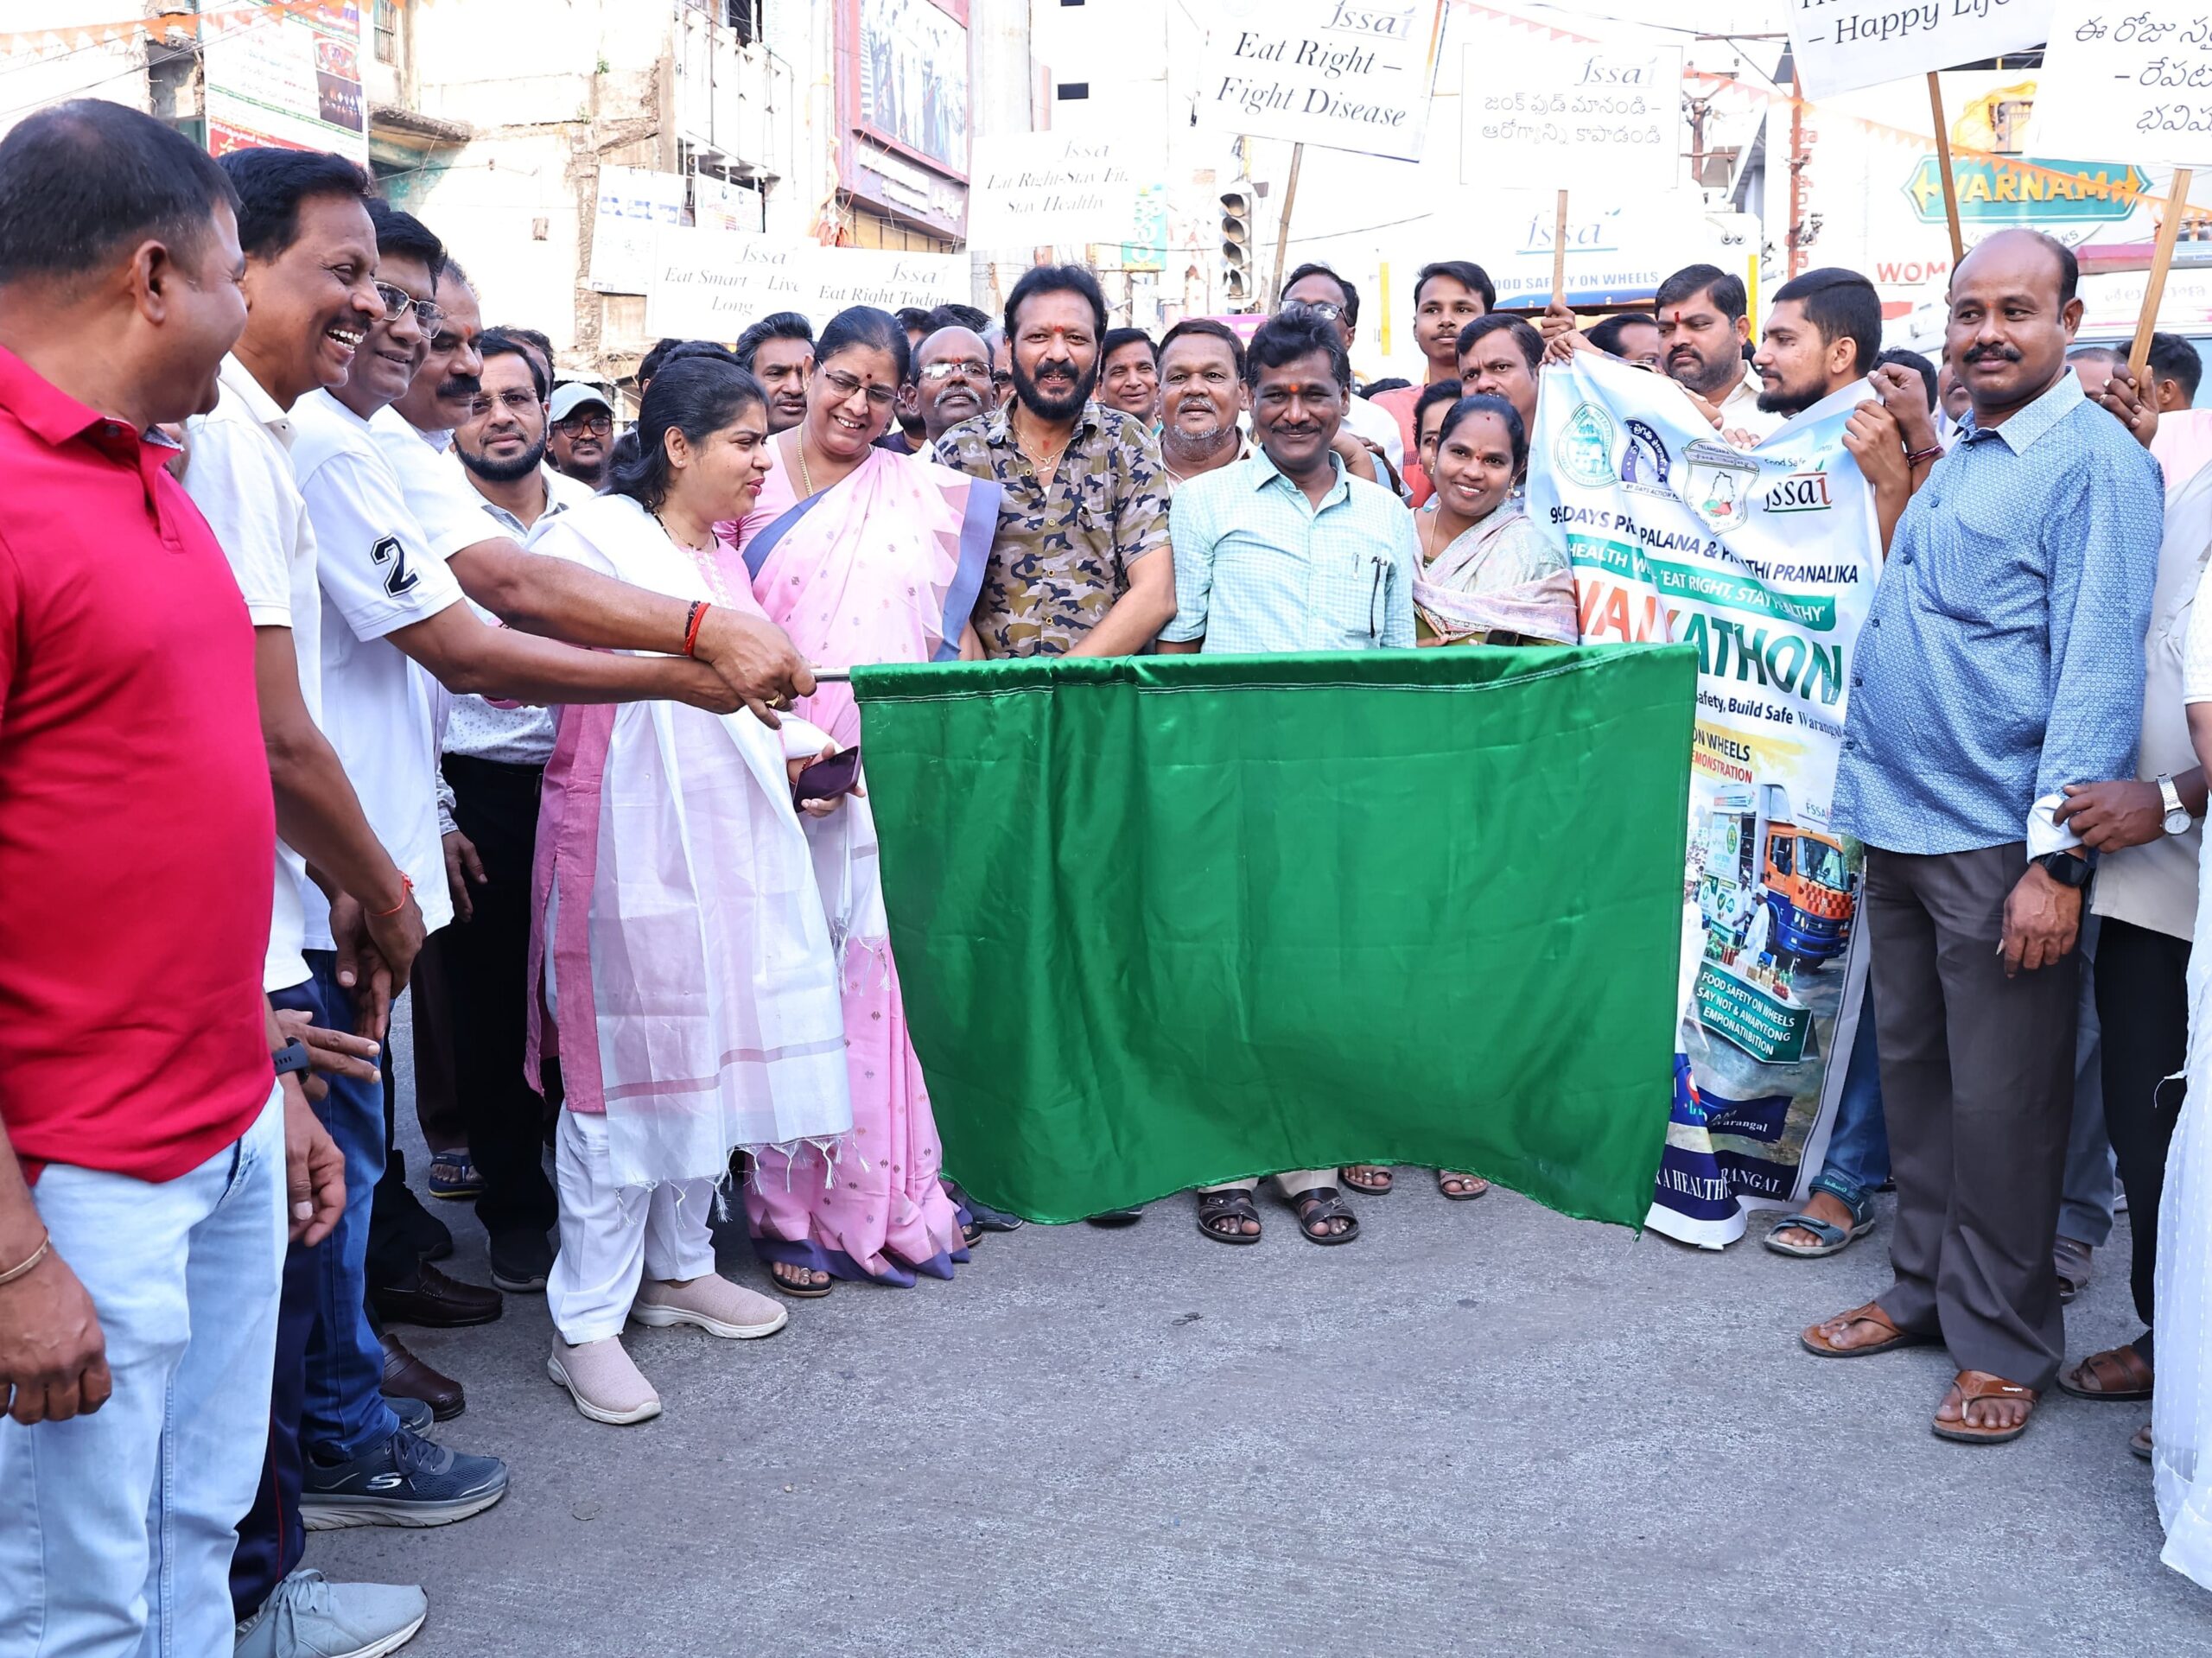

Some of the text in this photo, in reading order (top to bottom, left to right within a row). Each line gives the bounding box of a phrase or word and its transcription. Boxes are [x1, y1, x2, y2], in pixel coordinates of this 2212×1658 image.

[1834, 3, 1939, 45] Happy
[2075, 16, 2108, 41] ఈ
[2114, 11, 2177, 43] రోజు
[1233, 32, 1287, 62] Eat
[1294, 40, 1376, 79] Right
[1216, 76, 1406, 127] Fight Disease
[1484, 92, 1526, 111] జంక్
[1057, 137, 1116, 162] fssa
[1517, 208, 1621, 252] fssa
[664, 267, 693, 283] Eat
[697, 270, 747, 288] Smart
[767, 275, 801, 294] Live
[1494, 271, 1659, 290] OOD SAFY ON WHEELS
[1877, 261, 1955, 283] WOM
[712, 295, 754, 316] Long
[819, 285, 847, 302] Eat
[852, 288, 895, 308] Right
[1563, 505, 1611, 528] DAYS
[1640, 526, 1701, 555] PALANA
[1703, 541, 1718, 559] &
[1773, 562, 1859, 584] PRANALIKA
[371, 532, 421, 598] 2
[1735, 587, 1770, 608] STAY
[1696, 690, 1843, 739] afety, Build Safe Warangal
[1707, 732, 1751, 762] WHEELS
[1691, 749, 1753, 785] EMONSTRATION
[1696, 987, 1716, 1003] SAY
[1716, 994, 1733, 1013] NOT
[1732, 1006, 1740, 1017] &
[1701, 971, 1796, 1028] FOOD SAFETY ON WHEELS
[1713, 1120, 1768, 1134] arangal
[1663, 1167, 1671, 1190] A
[1720, 1167, 1783, 1194] RANGAL
